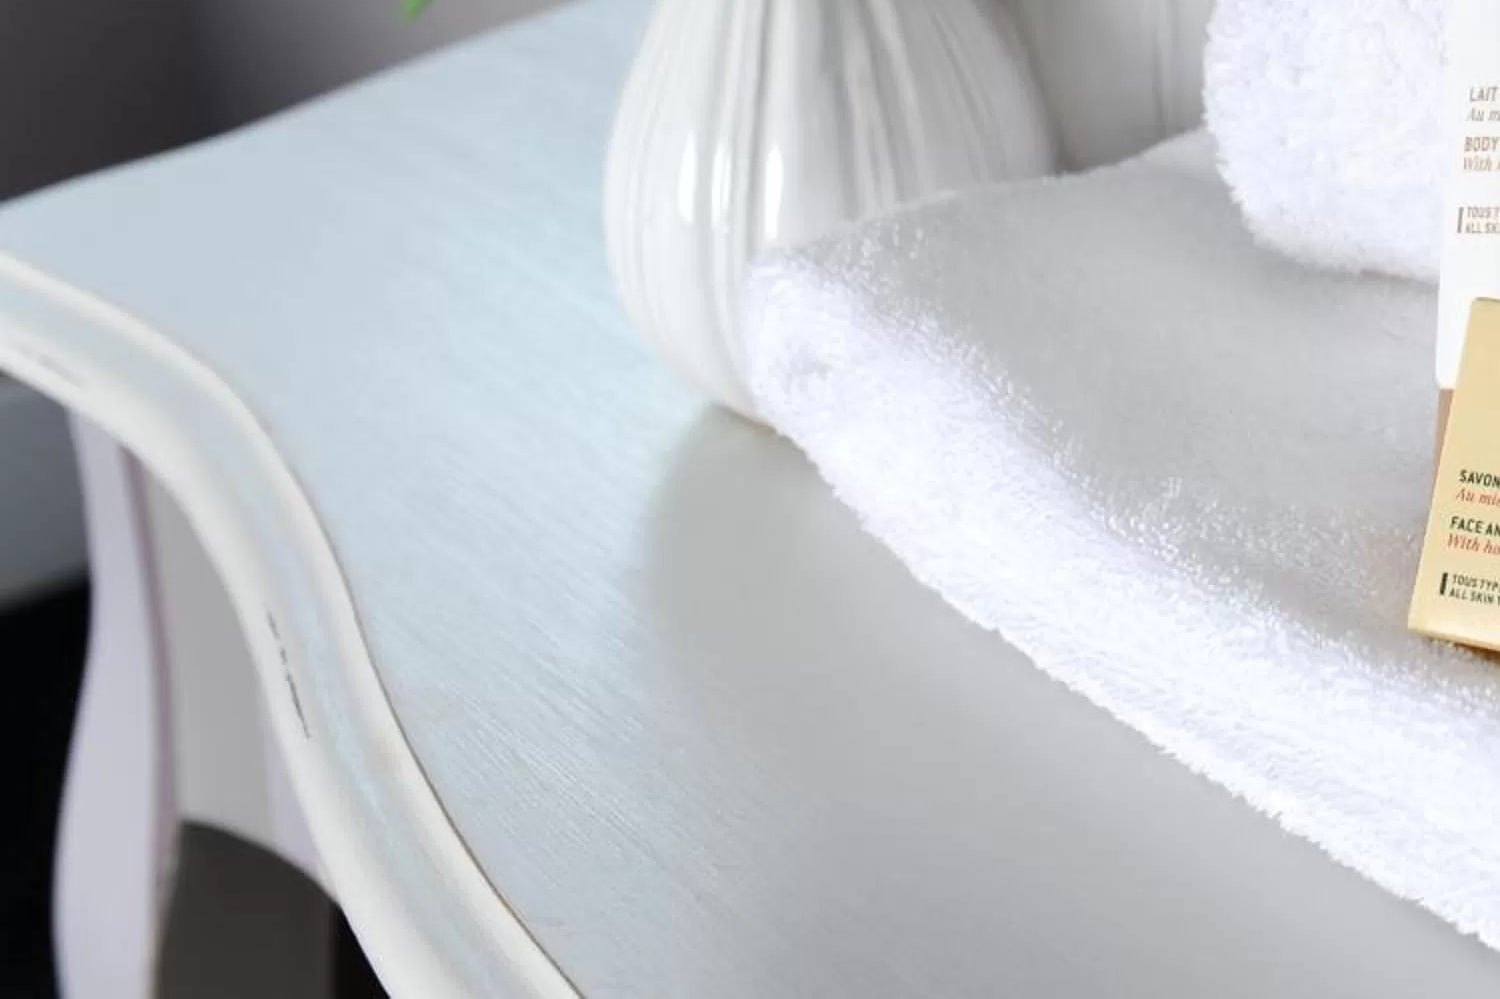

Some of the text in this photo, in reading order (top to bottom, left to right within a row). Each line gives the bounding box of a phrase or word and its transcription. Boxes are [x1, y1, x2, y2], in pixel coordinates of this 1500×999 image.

[1469, 86, 1499, 102] LAIT
[1466, 107, 1484, 122] Au
[1465, 136, 1500, 152] BODY
[1459, 469, 1500, 488] SAVON
[1456, 488, 1474, 502] Au
[1451, 516, 1483, 534] FACE
[1447, 533, 1479, 552] With
